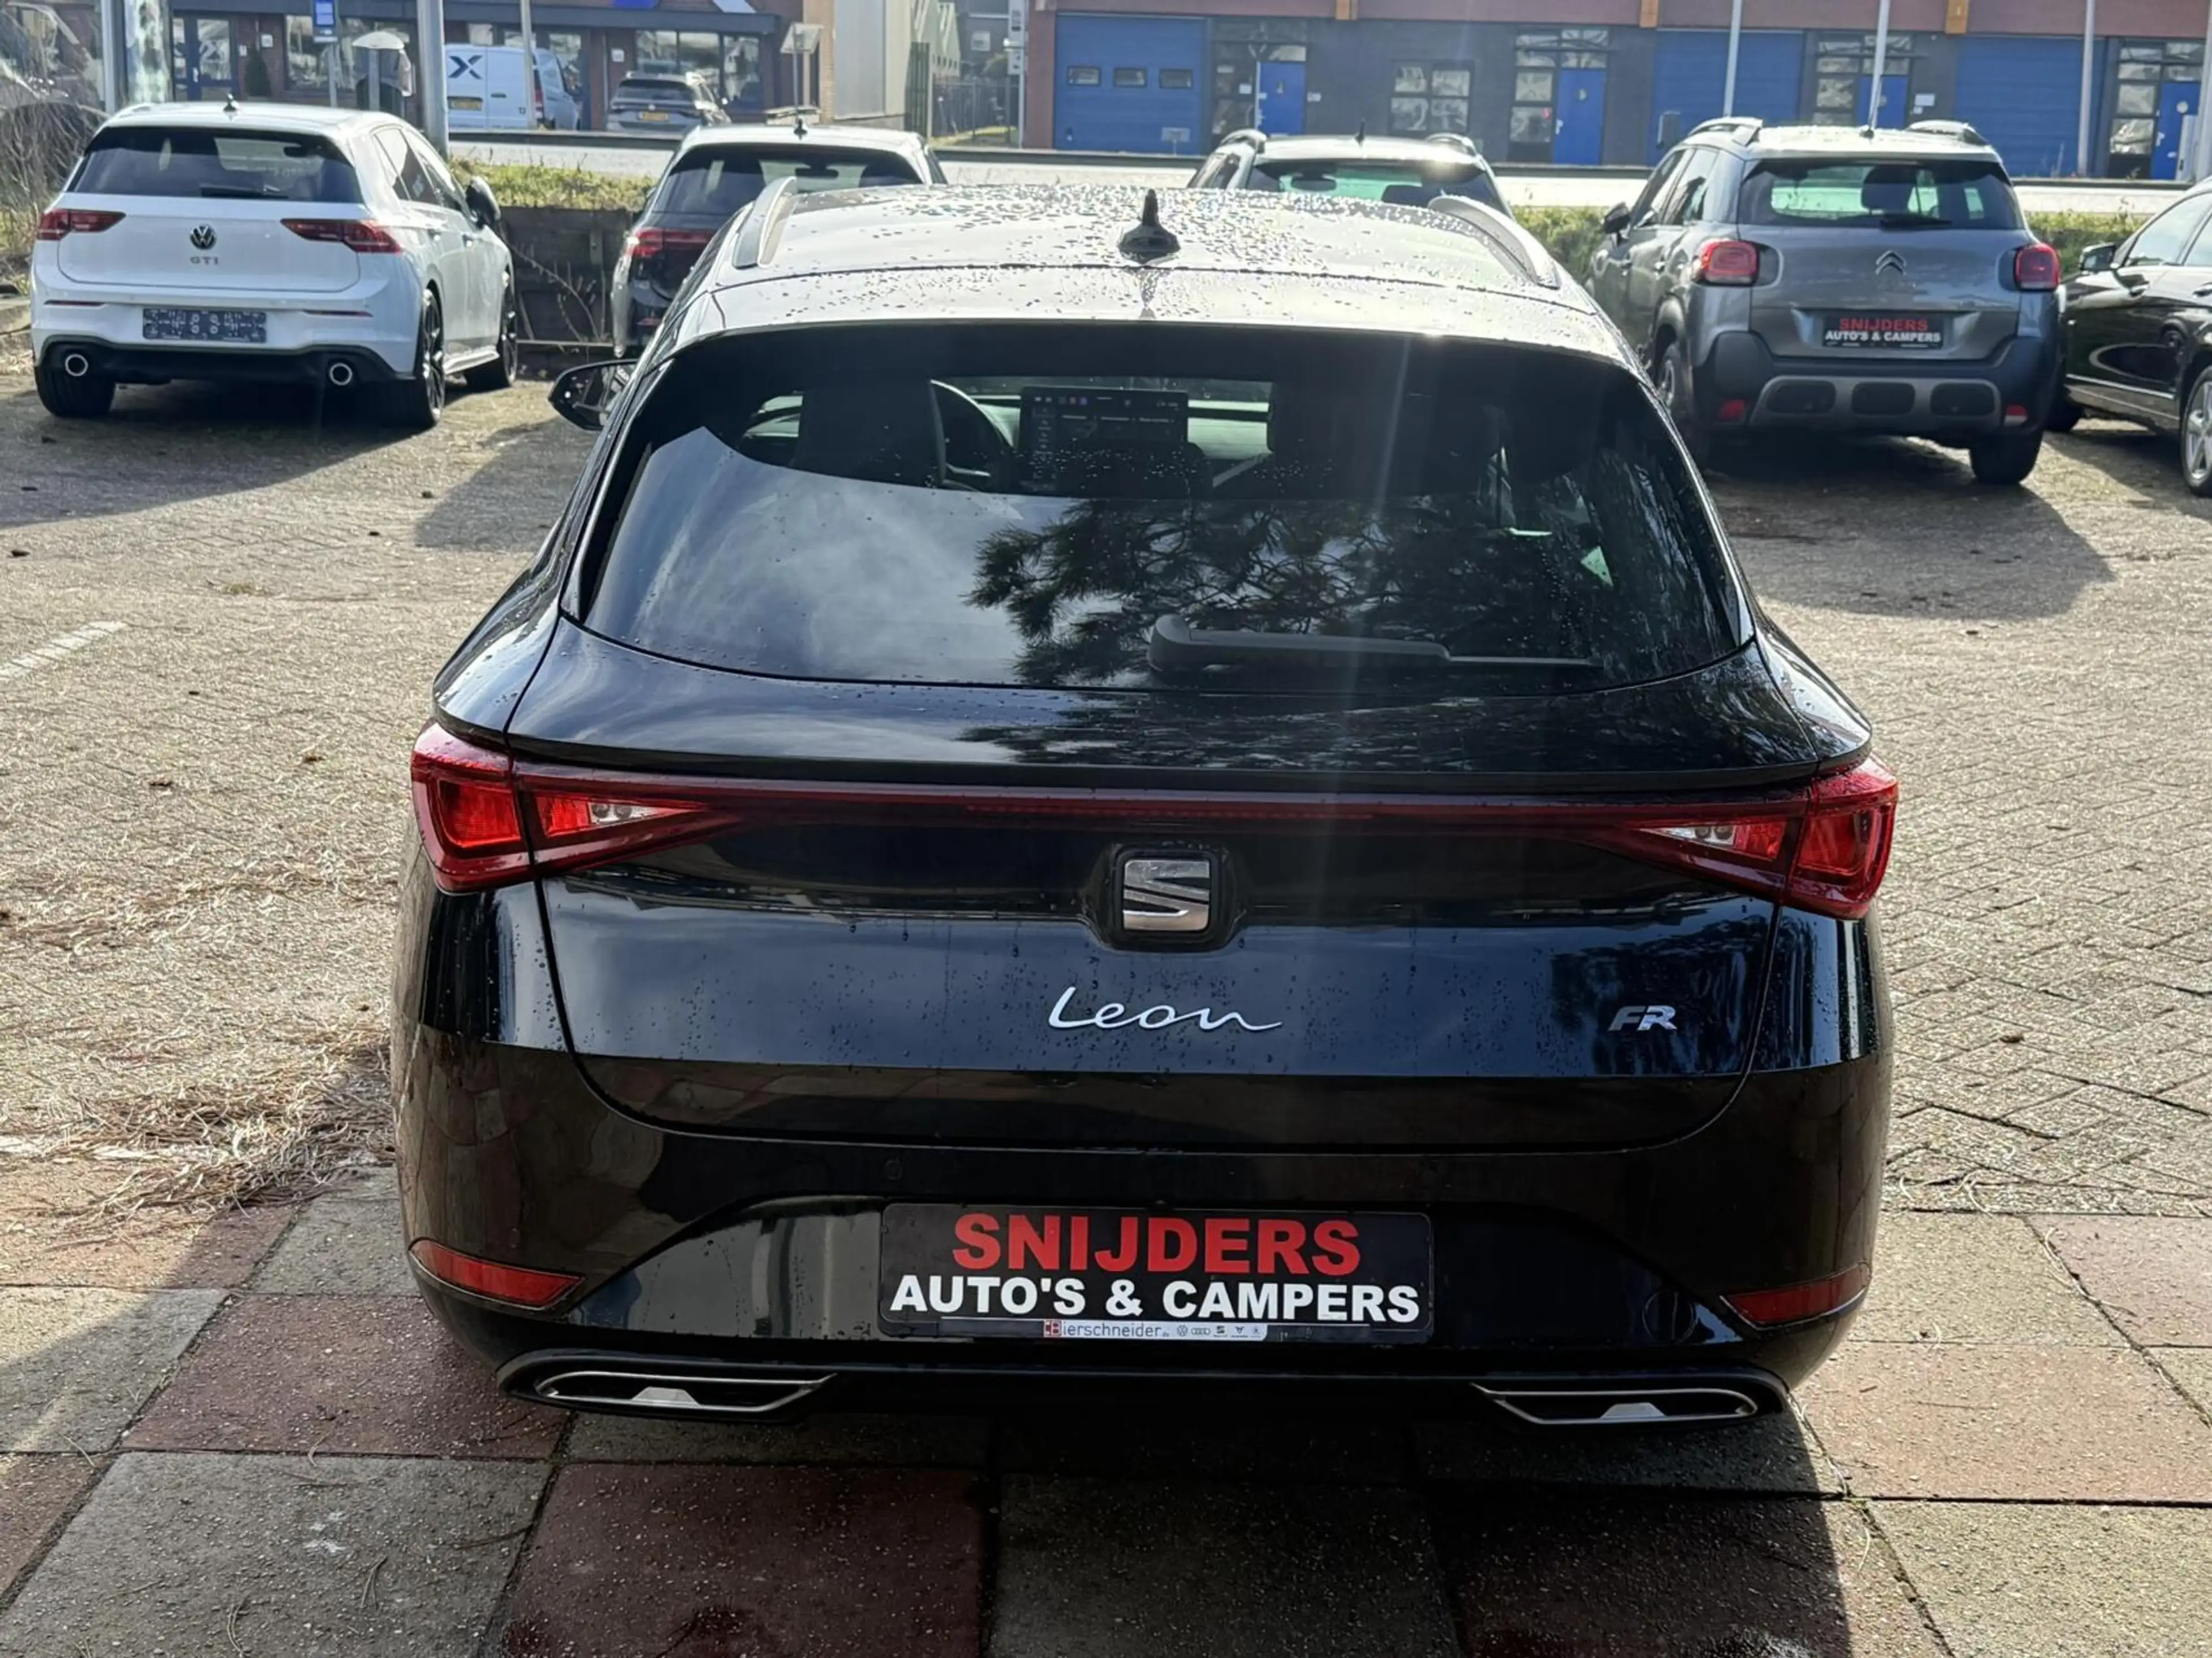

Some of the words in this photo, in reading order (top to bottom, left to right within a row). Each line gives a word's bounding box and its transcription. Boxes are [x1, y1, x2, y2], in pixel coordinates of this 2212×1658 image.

[190, 256, 218, 265] GTI
[1825, 331, 1868, 340] AUTO'S
[1884, 332, 1941, 342] CAMPERS
[1840, 318, 1928, 331] SNIJDERS
[1048, 987, 1281, 1030] Leon
[1608, 1006, 1677, 1031] FR
[953, 1213, 1360, 1276] SNIJDERS
[890, 1274, 1085, 1315] AUTO'S
[1105, 1279, 1143, 1317] &
[1162, 1280, 1419, 1322] CAMPERS
